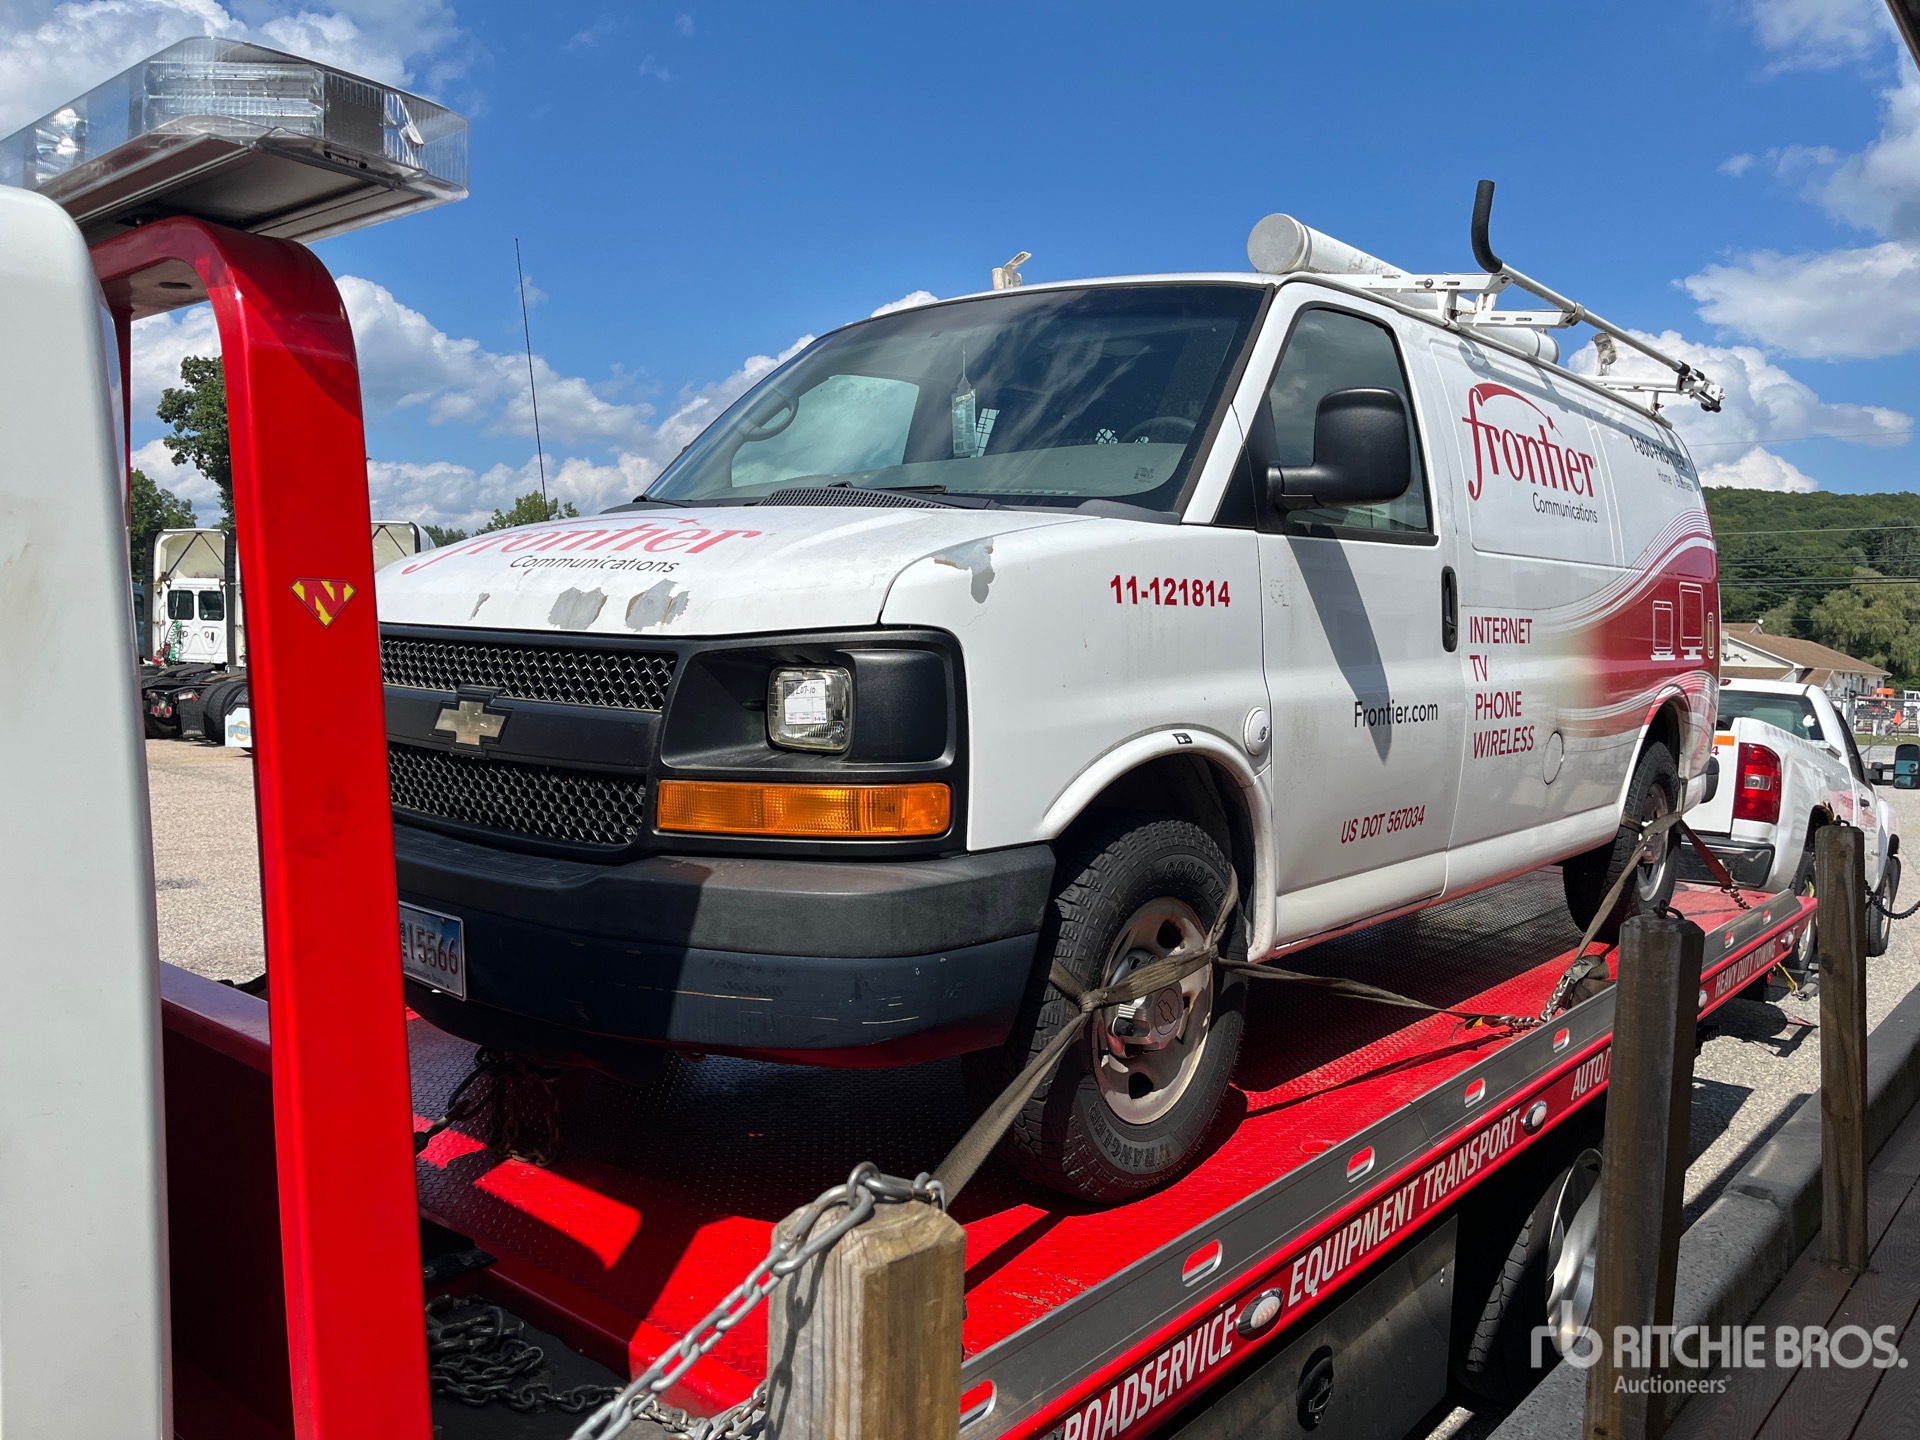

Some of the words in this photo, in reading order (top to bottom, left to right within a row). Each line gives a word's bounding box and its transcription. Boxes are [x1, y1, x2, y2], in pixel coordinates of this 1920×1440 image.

[1462, 383, 1593, 500] frontier
[1532, 492, 1598, 523] Communications
[401, 516, 762, 576] frontier
[510, 555, 680, 574] Communications
[301, 580, 350, 618] N
[1110, 574, 1231, 608] 11-121814
[1469, 616, 1533, 644] INTERNET
[1469, 654, 1489, 682] TV
[1354, 699, 1439, 728] Frontier.com
[1475, 691, 1522, 721] PHONE
[1473, 725, 1535, 759] WIRELESS
[1341, 819, 1359, 844] US
[1360, 813, 1386, 839] DOT
[1386, 805, 1426, 833] 567034
[406, 923, 459, 975] 15566
[1715, 962, 1739, 998] HEAVY
[1737, 951, 1755, 983] DUTY
[1288, 1176, 1421, 1307] EQUIPMENT
[1422, 1109, 1521, 1209] TRANSPORT
